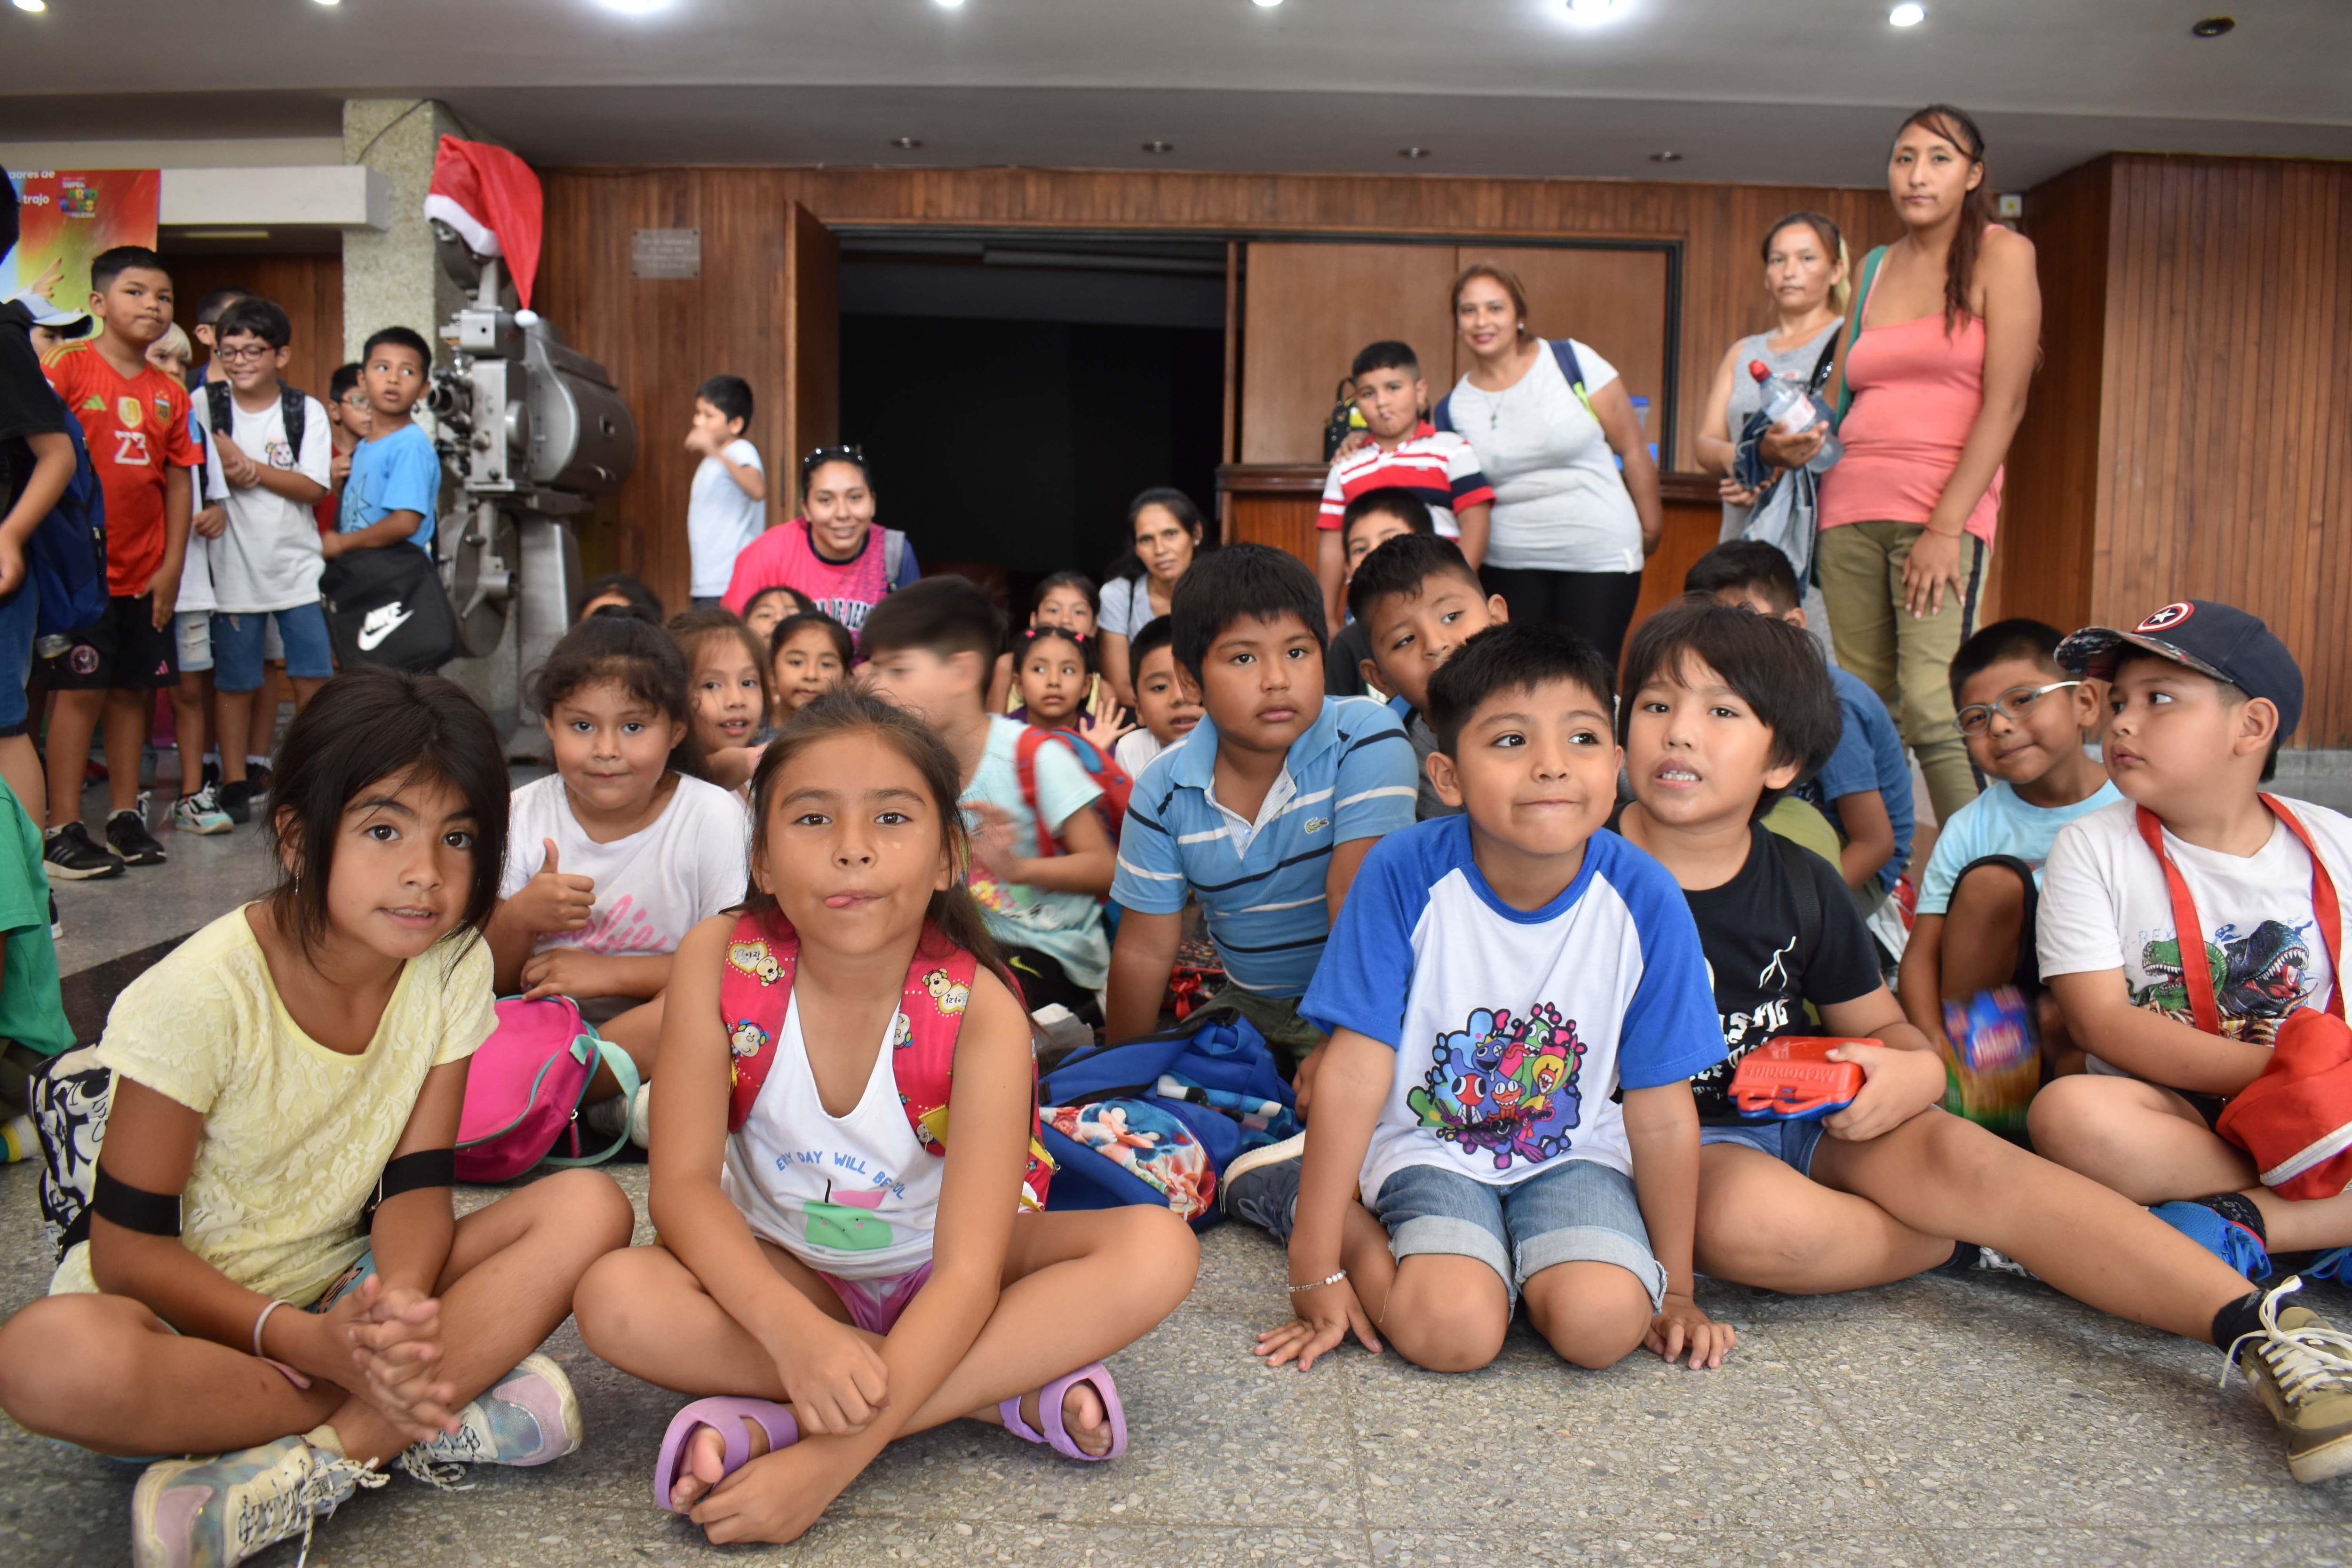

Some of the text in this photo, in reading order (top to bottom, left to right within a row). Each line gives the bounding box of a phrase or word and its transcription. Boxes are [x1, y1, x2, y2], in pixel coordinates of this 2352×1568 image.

[23, 194, 49, 206] trajo
[796, 1151, 823, 1164] DAY
[834, 1152, 866, 1175] WILL
